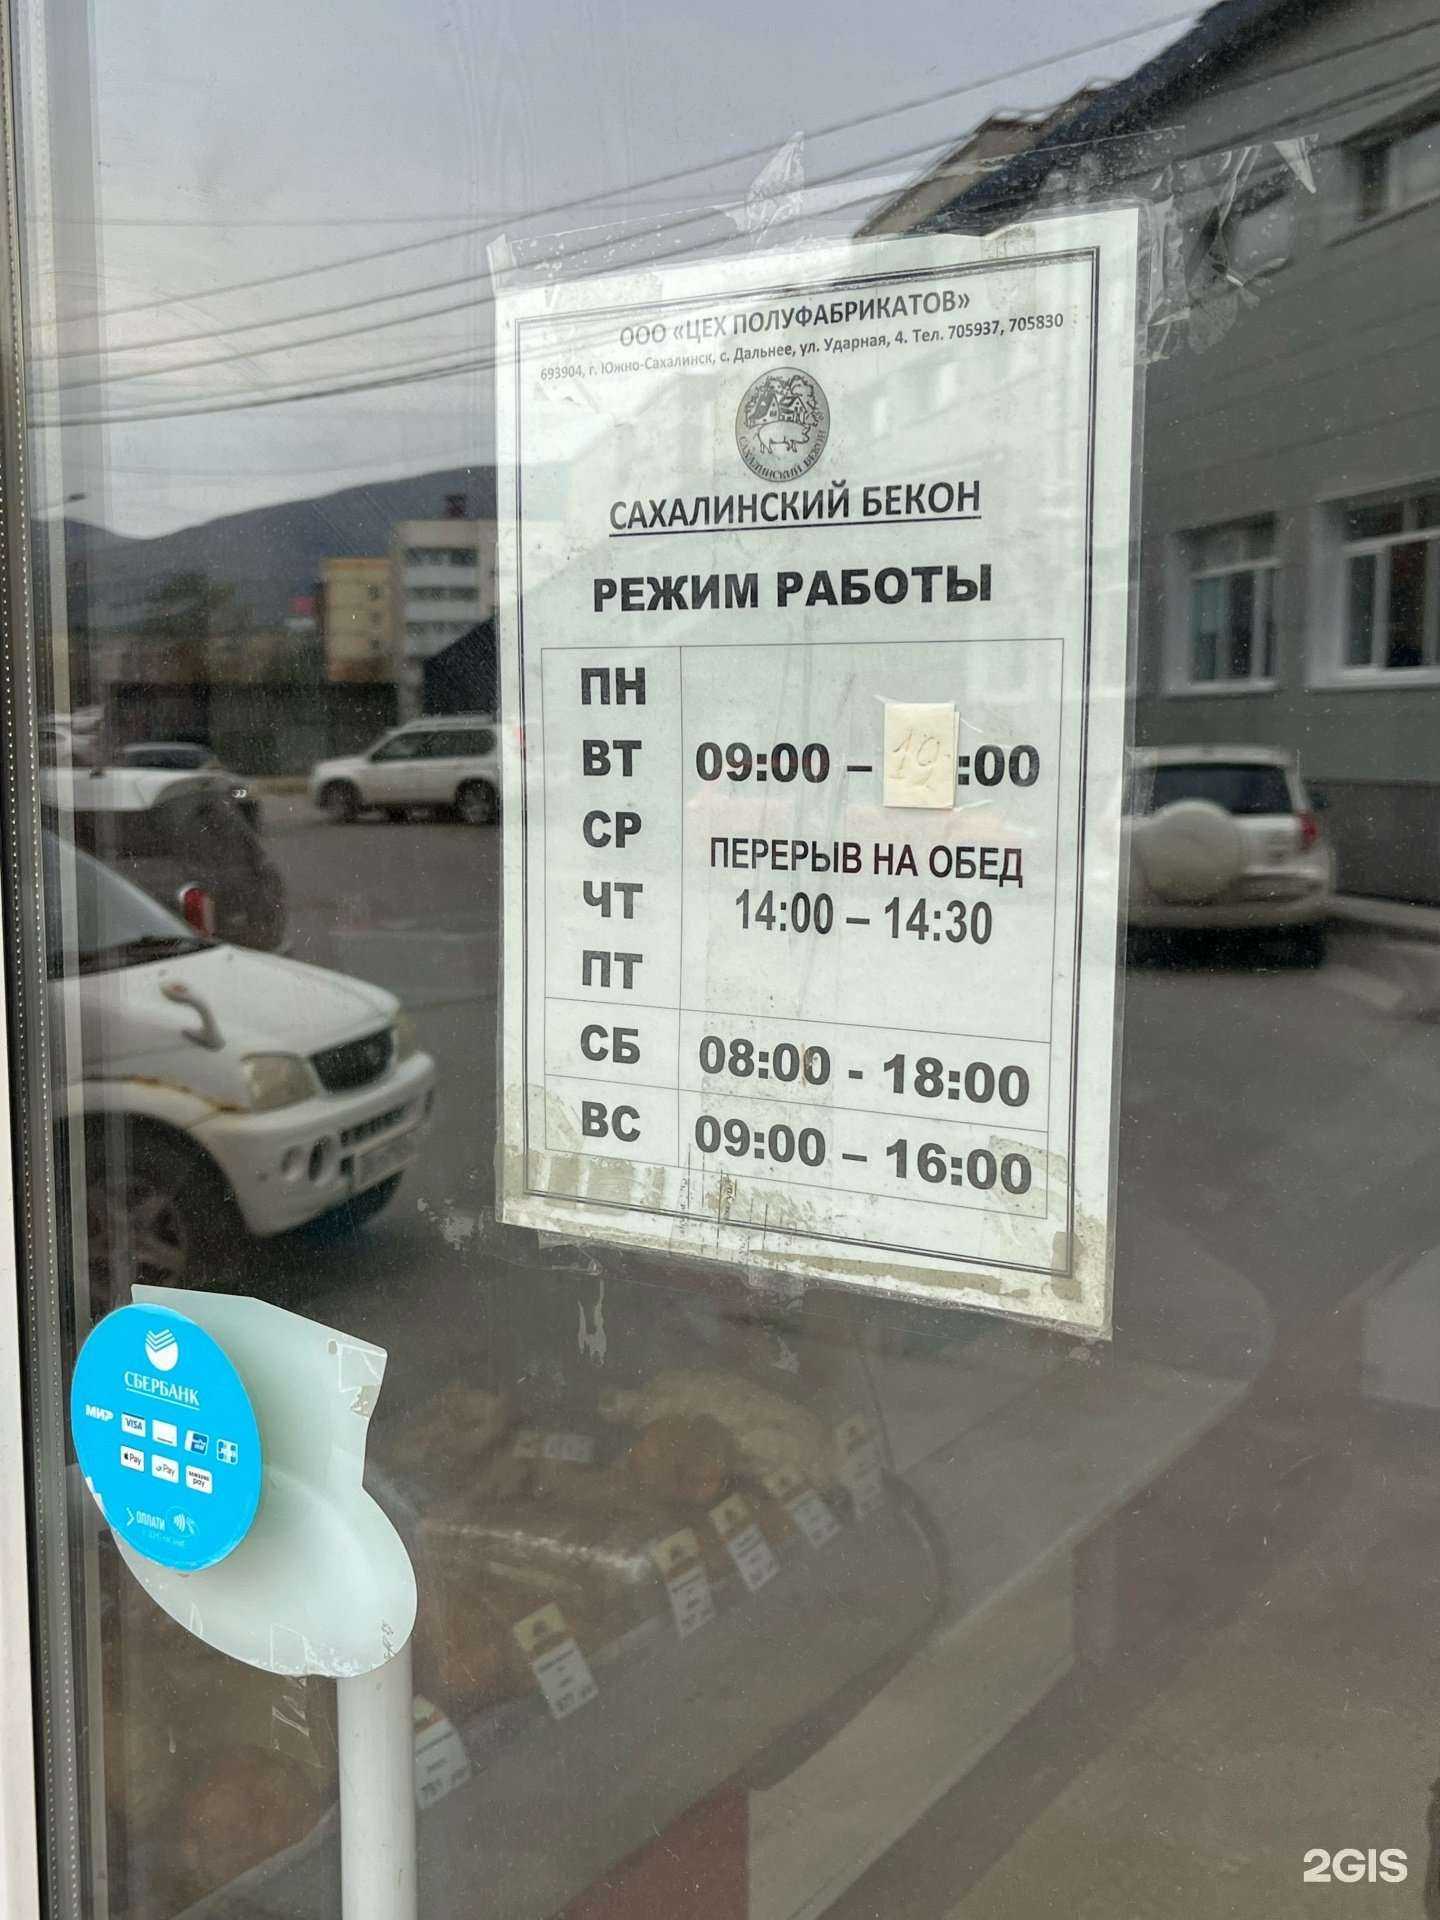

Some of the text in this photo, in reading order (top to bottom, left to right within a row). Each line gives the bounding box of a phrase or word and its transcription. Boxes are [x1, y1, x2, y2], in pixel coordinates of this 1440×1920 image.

[620, 290, 970, 347] ООО «ЦЕХ ПОЛУФАБРИКАТОВ»
[540, 365, 586, 381] 693904,
[601, 353, 716, 374] Южно-Сахалинск,
[719, 351, 730, 362] с.
[733, 341, 796, 365] Дальнее,
[799, 342, 820, 356] ул.
[824, 334, 891, 353] Ударная,
[895, 331, 907, 344] 4.
[912, 328, 944, 344] Тел.
[949, 319, 1004, 340] 705937,
[1009, 313, 1064, 331] 705830
[609, 480, 981, 529] САХАЛИНСКИЙ БЕКОН
[594, 564, 992, 612] РЕЖИМ РАБОТЫ
[580, 667, 646, 705] ПН
[582, 740, 643, 777] ВТ
[696, 742, 830, 784] 09:00
[582, 810, 642, 848] СР
[710, 837, 1023, 888] ПЕРЕРЫВ НА ОБЕД
[583, 880, 643, 919] ЧТ
[735, 888, 834, 935] 14:00
[884, 896, 993, 945] 14:30
[582, 949, 643, 989] ПТ
[580, 1025, 641, 1064] СБ
[699, 1035, 831, 1086] 08:00
[883, 1053, 1030, 1107] 18:00
[581, 1100, 641, 1142] ВС
[695, 1114, 826, 1167] 09:00
[886, 1138, 1032, 1195] 16:00
[124, 1370, 200, 1407] СБЕРБАНК
[85, 1403, 114, 1422] МИР
[125, 1417, 143, 1431] VISA
